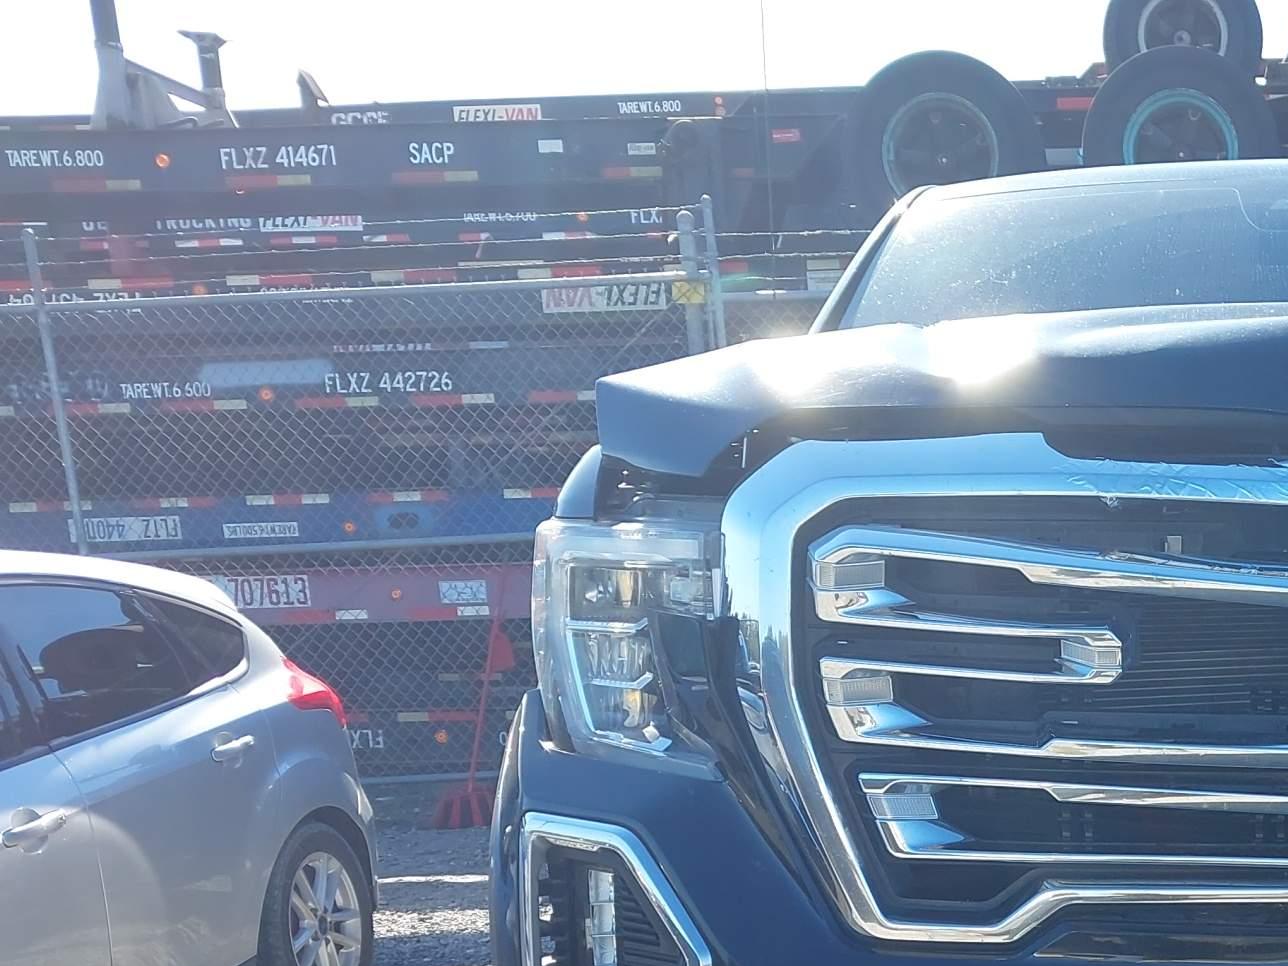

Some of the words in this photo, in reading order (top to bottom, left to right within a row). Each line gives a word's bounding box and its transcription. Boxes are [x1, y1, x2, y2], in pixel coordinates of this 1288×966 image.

[220, 148, 269, 169] FLXZ
[275, 145, 337, 168] 414671
[408, 143, 454, 163] SACP
[324, 372, 371, 393] FLXZ
[379, 370, 453, 392] 442726
[228, 576, 308, 606] 707613
